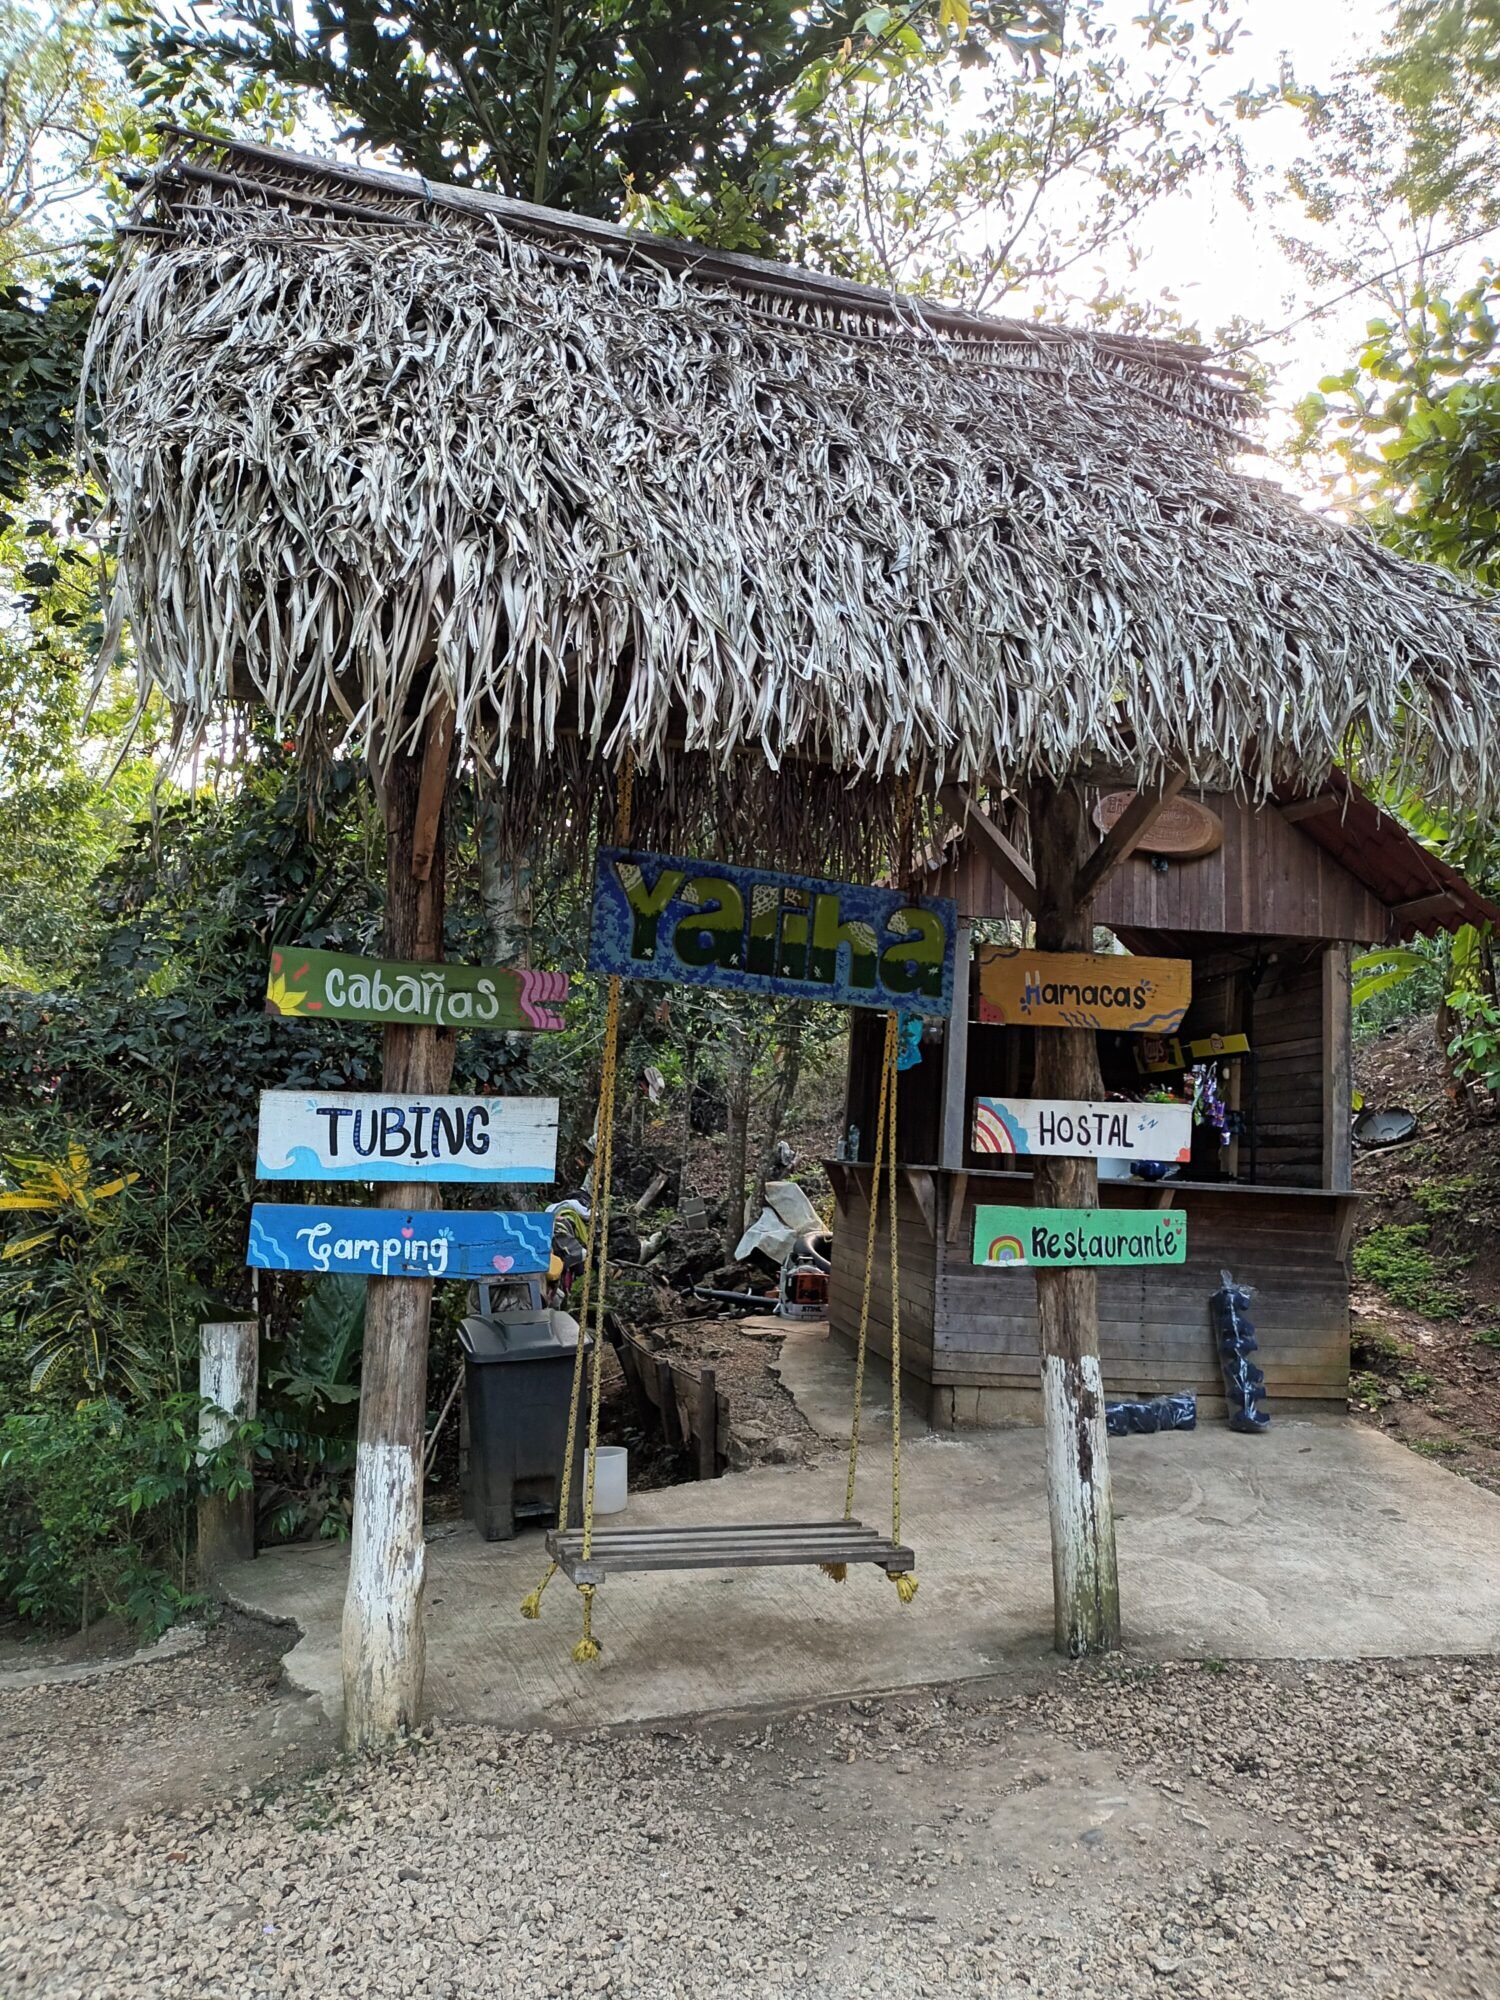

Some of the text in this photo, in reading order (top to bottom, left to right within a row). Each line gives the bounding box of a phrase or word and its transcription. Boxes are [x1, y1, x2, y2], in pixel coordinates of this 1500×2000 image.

[615, 861, 945, 997] Yaliha
[325, 968, 500, 1025] Cabañas
[1025, 970, 1146, 1010] Hamacas
[316, 1105, 490, 1159] TUBING
[1039, 1111, 1134, 1148] HOSTAL
[296, 1222, 449, 1276] Camping
[1031, 1225, 1178, 1259] Restaurante
